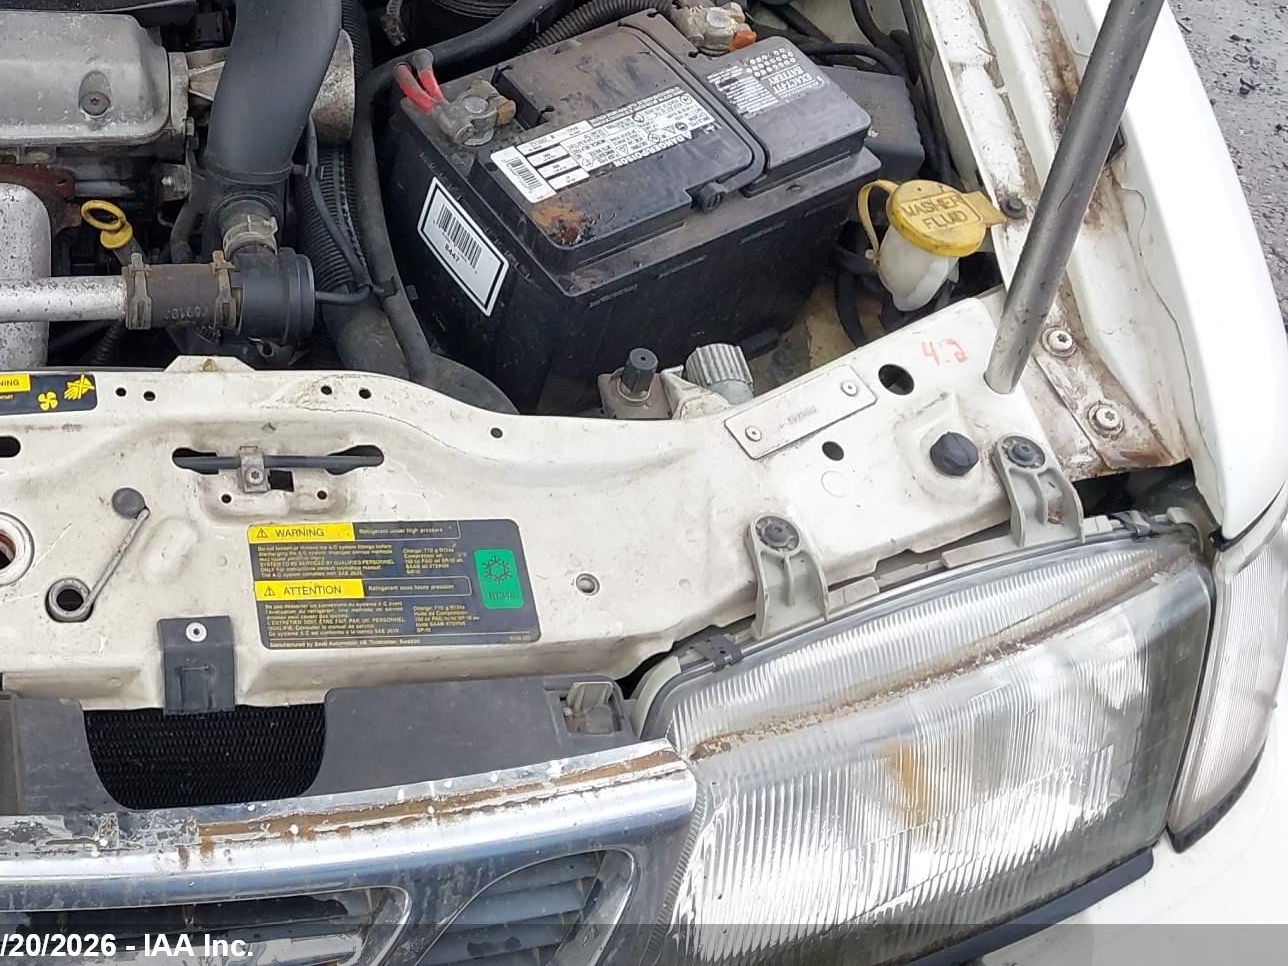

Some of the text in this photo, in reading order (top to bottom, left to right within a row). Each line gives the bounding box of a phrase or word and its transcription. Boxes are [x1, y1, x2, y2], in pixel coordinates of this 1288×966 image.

[900, 195, 963, 217] WASHER
[923, 210, 968, 230] FLUID
[275, 528, 325, 538] WARNING
[283, 585, 342, 595] ATTENTION
